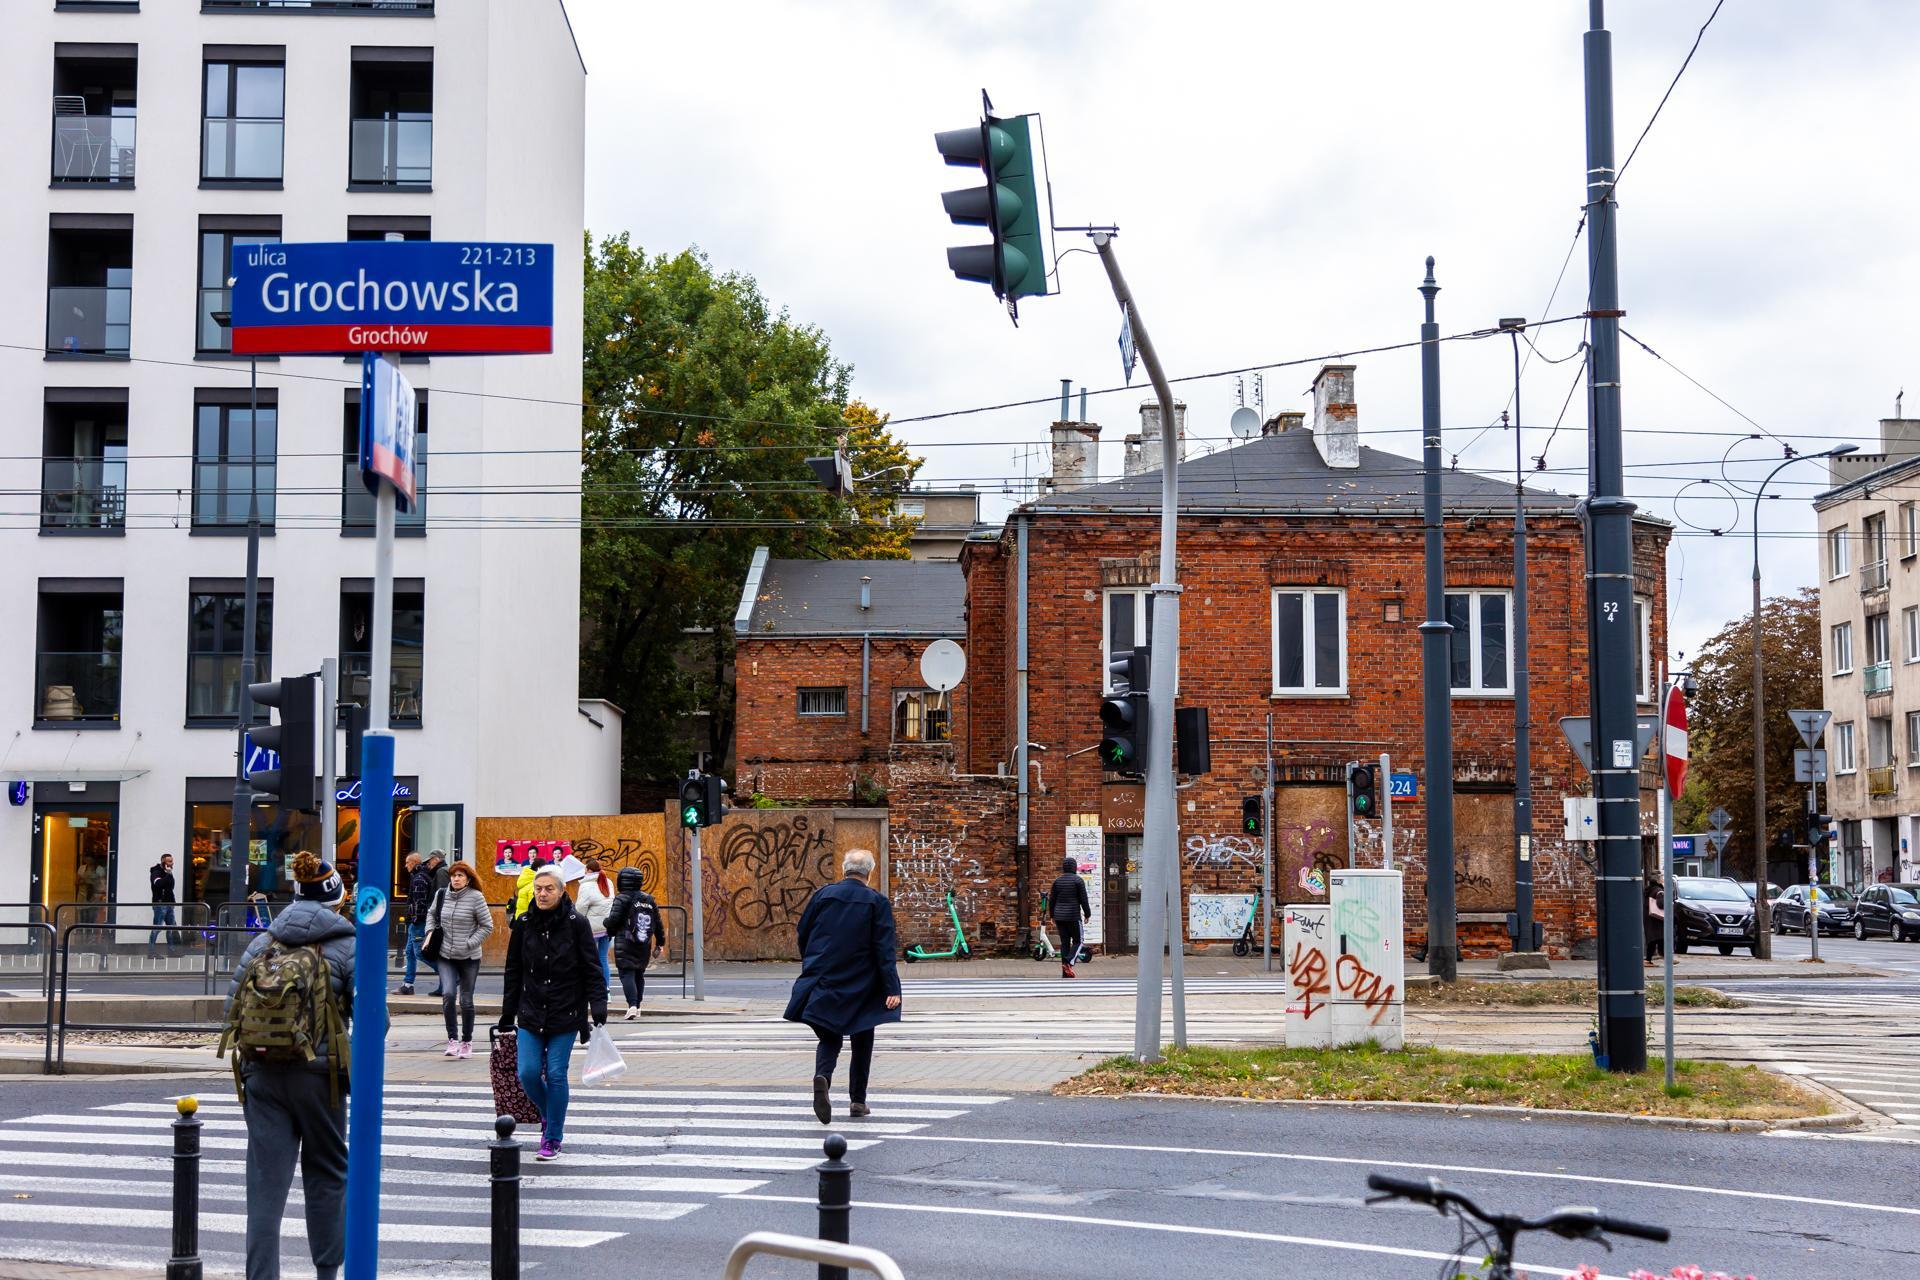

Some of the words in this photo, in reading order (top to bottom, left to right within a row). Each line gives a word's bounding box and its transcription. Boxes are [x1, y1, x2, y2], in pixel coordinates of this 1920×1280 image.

[248, 244, 287, 266] ulica
[461, 247, 536, 266] 221-213
[262, 268, 518, 313] Grochowska
[348, 326, 428, 345] Grochów
[1603, 601, 1619, 612] 52
[1607, 612, 1615, 622] 4
[1390, 781, 1411, 795] 224
